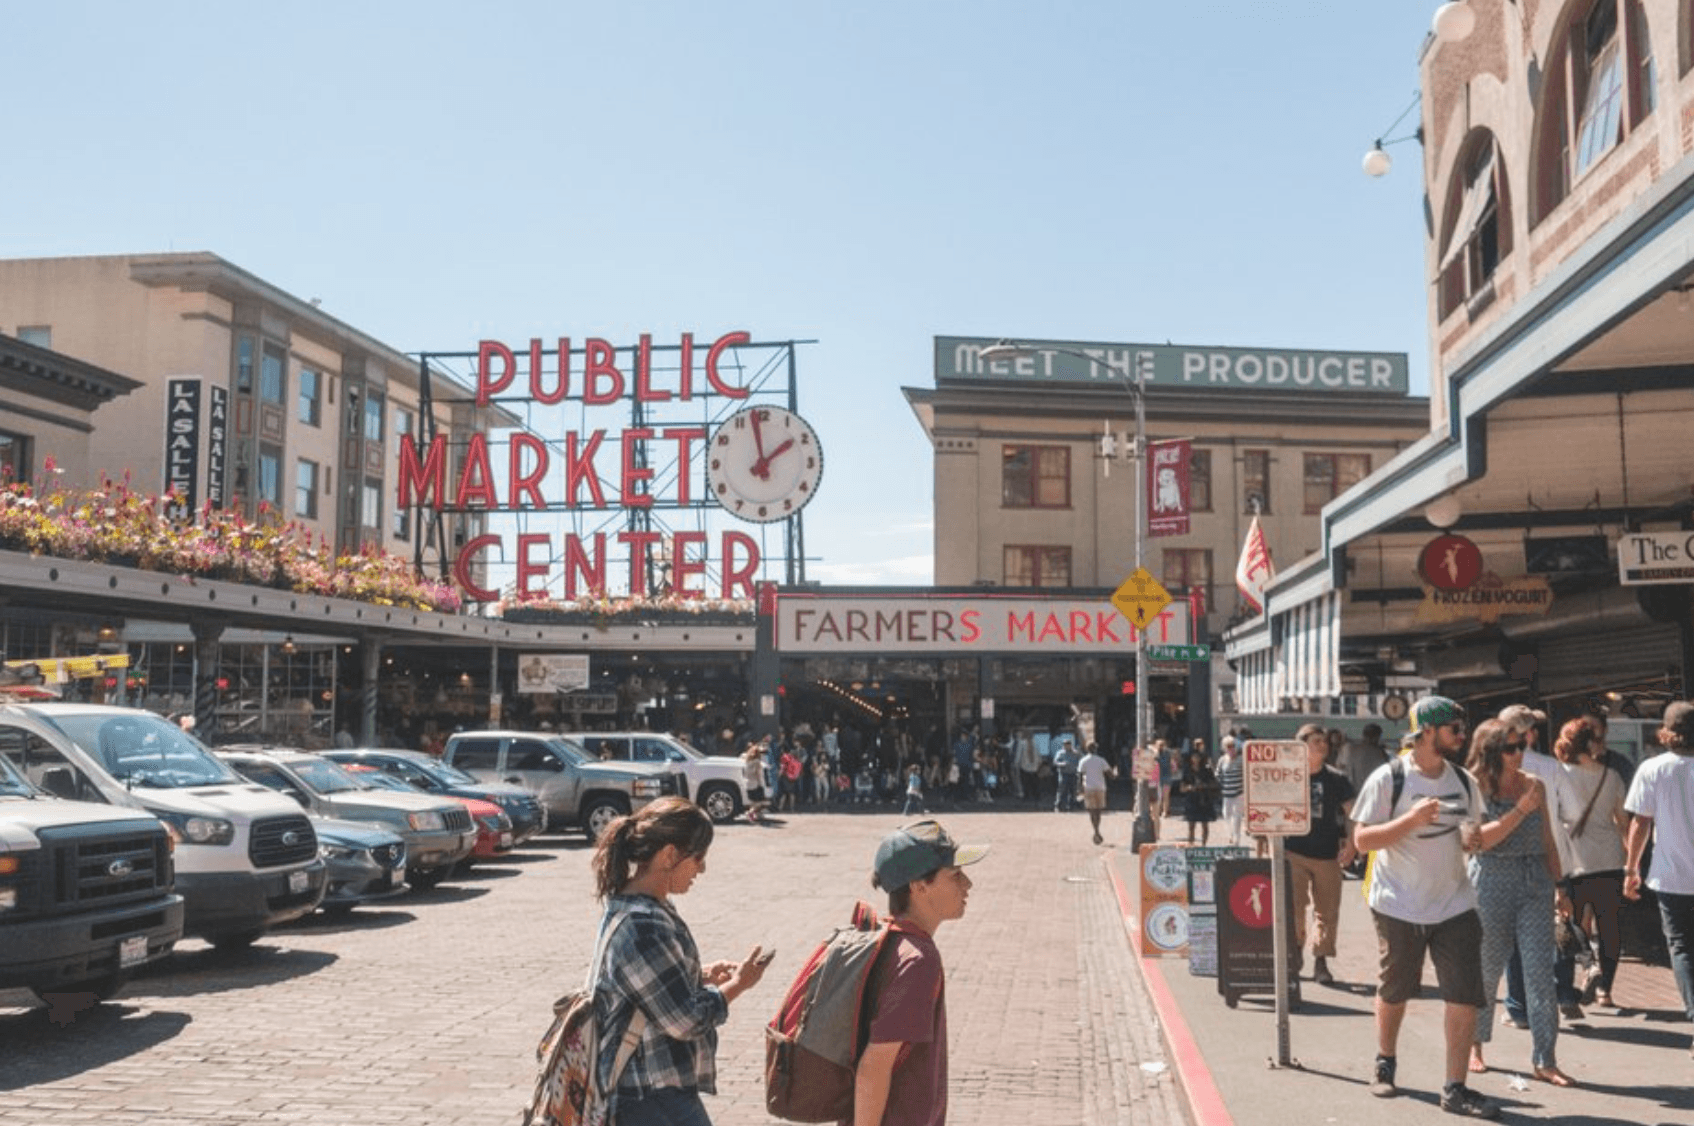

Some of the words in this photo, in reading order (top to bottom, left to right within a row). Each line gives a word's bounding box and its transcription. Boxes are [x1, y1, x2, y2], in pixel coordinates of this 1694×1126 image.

[476, 331, 751, 407] PUBLIC
[956, 345, 1058, 376] MEET
[1084, 348, 1155, 380] THE
[1183, 352, 1393, 387] PRODUCER
[801, 432, 809, 445] 2
[399, 428, 706, 511] MARKET
[453, 530, 761, 601] CENTER
[1631, 537, 1678, 564] The
[795, 610, 983, 643] FARMERS
[1008, 611, 1174, 643] MARKT
[1250, 745, 1275, 761] NO
[1252, 767, 1303, 783] STOPS
